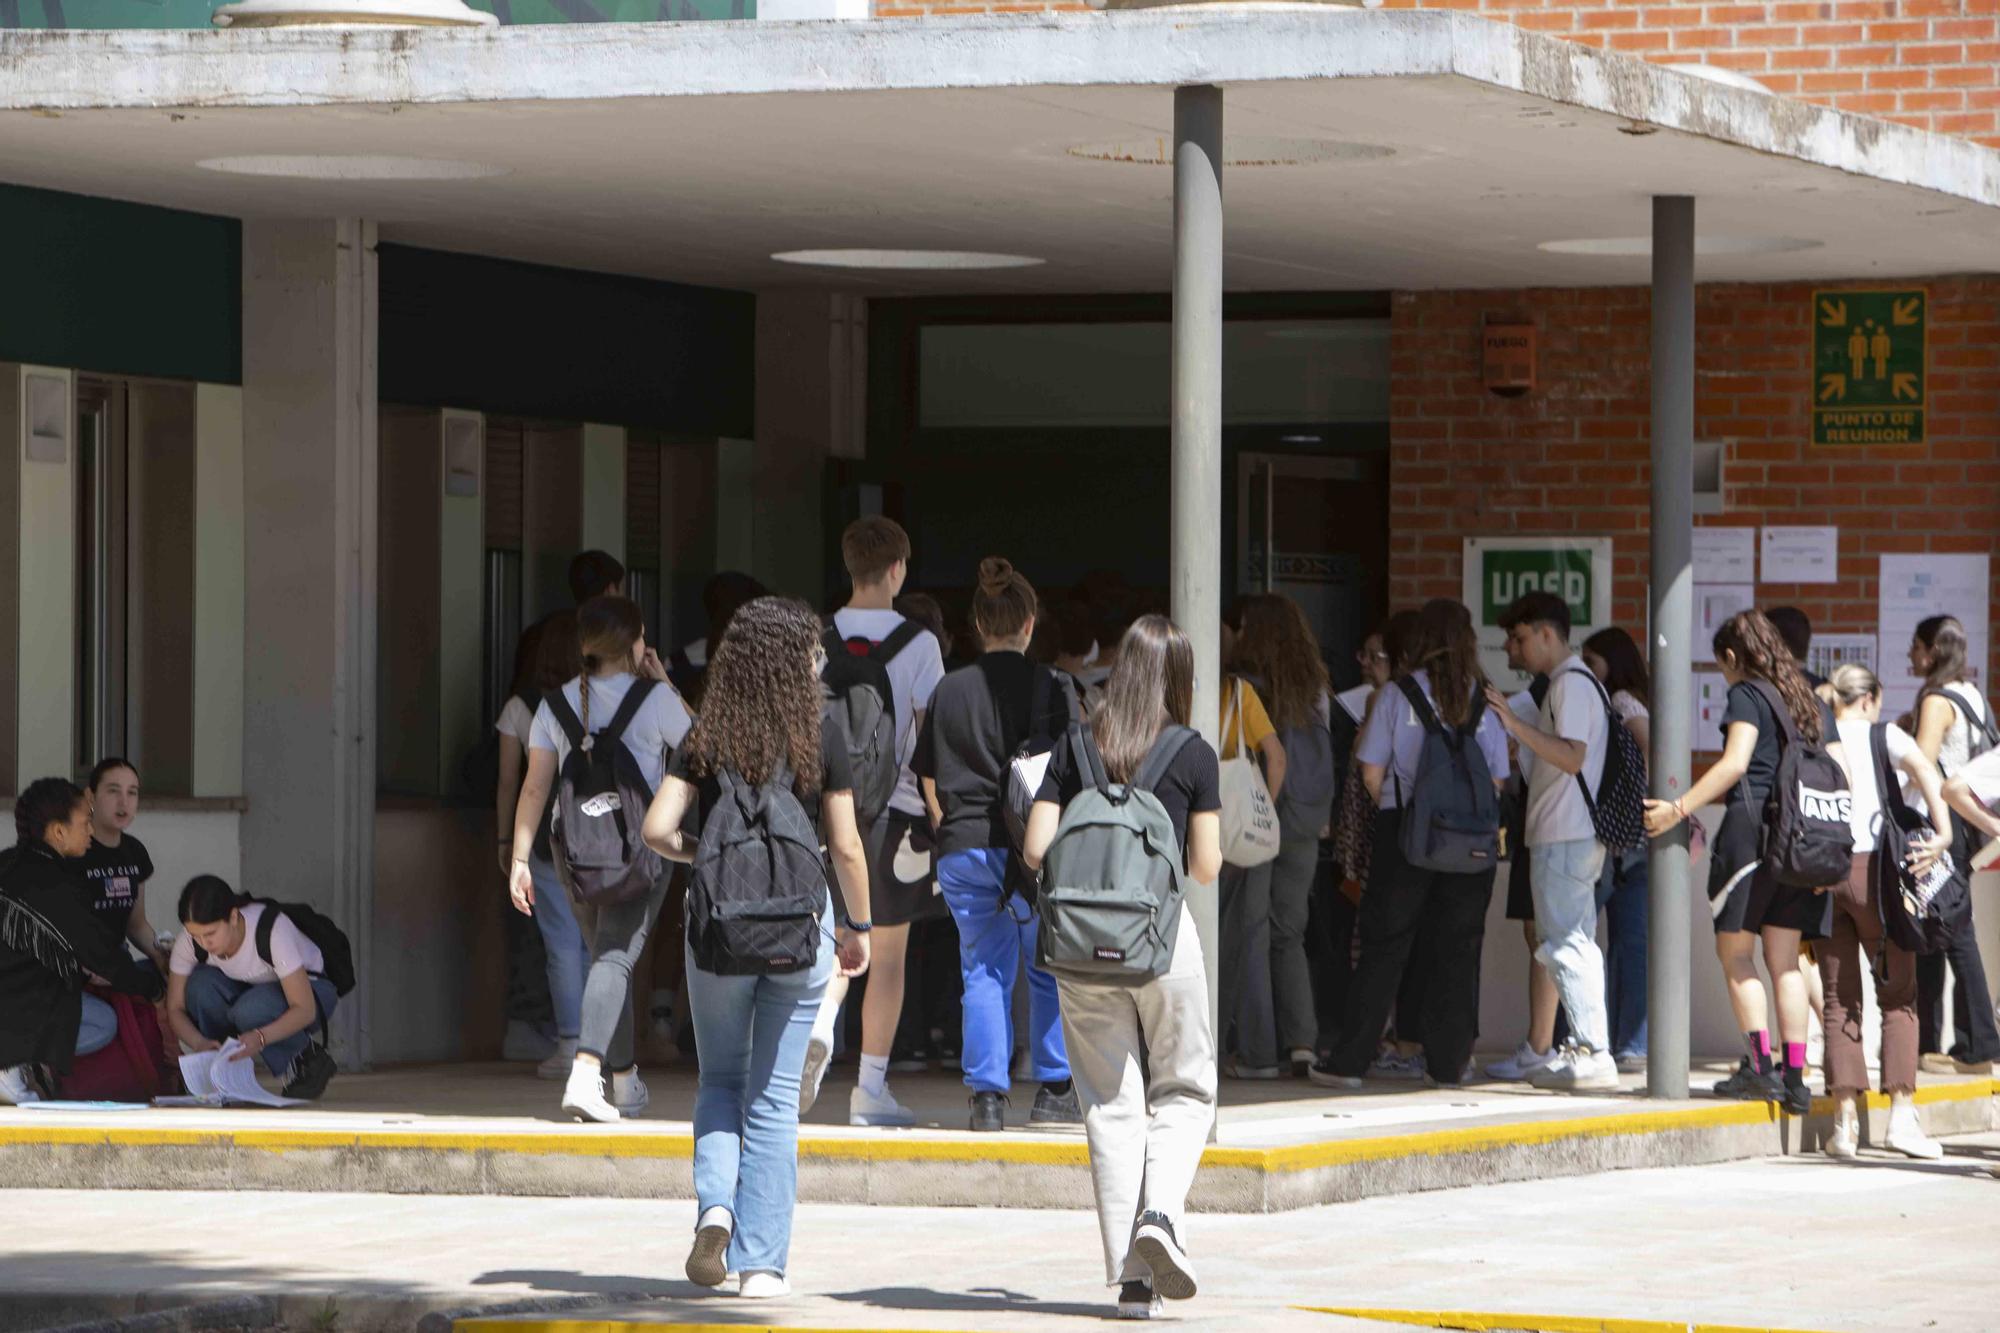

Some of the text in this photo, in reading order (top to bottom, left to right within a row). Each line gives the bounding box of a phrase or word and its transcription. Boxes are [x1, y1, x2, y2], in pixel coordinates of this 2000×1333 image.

[1822, 410, 1916, 426] PUNTO DE
[1826, 427, 1910, 442] REUNION
[86, 864, 140, 879] POLO CLUB
